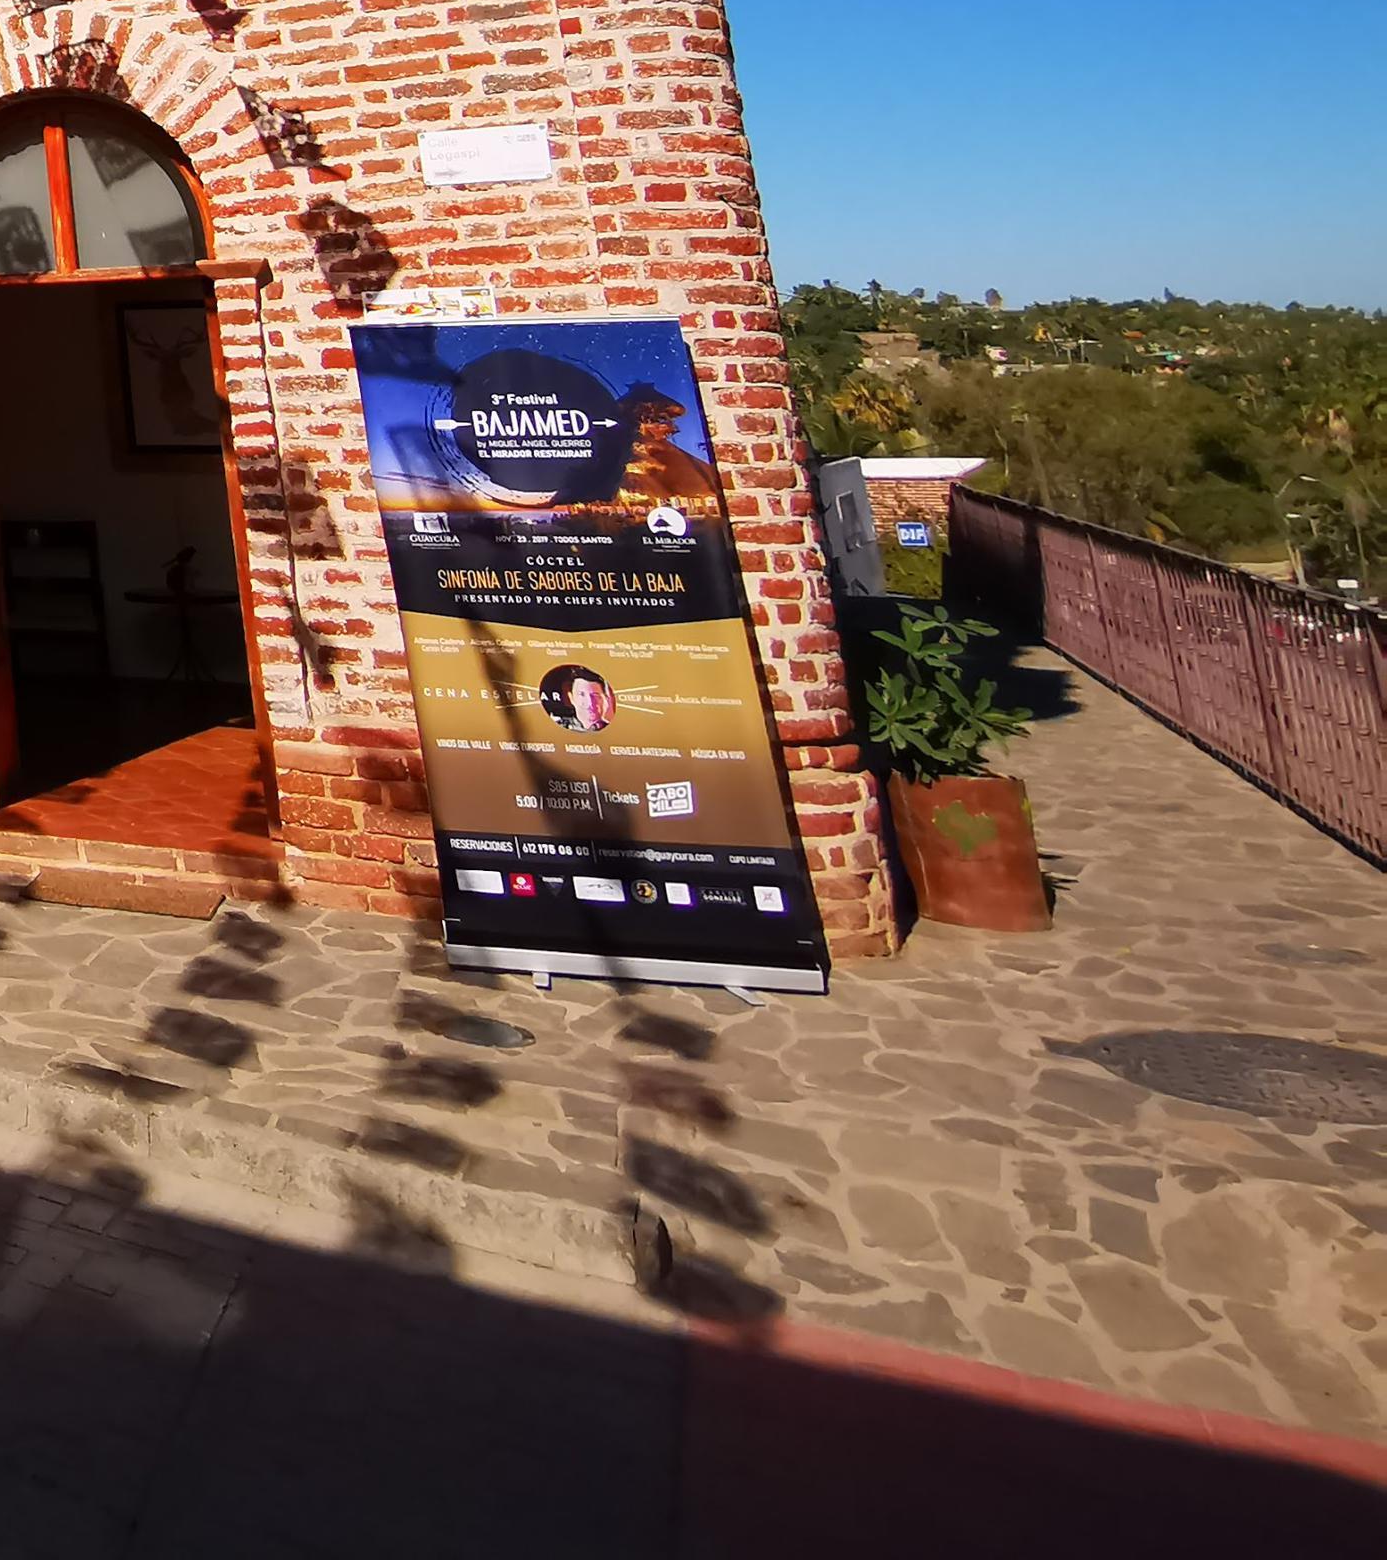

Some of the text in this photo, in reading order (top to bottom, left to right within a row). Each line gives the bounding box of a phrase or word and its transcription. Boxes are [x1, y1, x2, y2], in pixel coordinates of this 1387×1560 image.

[506, 393, 559, 405] Festival
[471, 409, 590, 437] BAJAMED
[477, 440, 487, 448] by
[488, 440, 520, 448] MIGUEL
[478, 449, 593, 458] EL MIRADOR RESTAURANT
[409, 534, 460, 543] GUAYCURA
[553, 535, 580, 544] TODOS
[580, 536, 614, 544] SANTOS
[642, 536, 697, 545] EL MIRADOR
[899, 528, 924, 541] DIF
[526, 555, 585, 566] CÓCTEL
[437, 566, 686, 593] SINFONÍA DE SABORES DE LA BAJA
[454, 593, 676, 607] PRESENTADO POR CHEFS INVITADOS
[423, 687, 562, 701] CENA ESTELAR
[436, 738, 492, 750] VINOS DEL VALLE
[609, 746, 642, 756] CERVEZA
[569, 781, 590, 794] USD
[647, 786, 687, 801] CABO
[515, 795, 538, 809] 5:00
[602, 791, 640, 805] Tickets
[648, 799, 673, 812] MIL
[449, 838, 514, 852] RESERVACIONES
[522, 843, 537, 854] 612
[558, 844, 573, 856] 08
